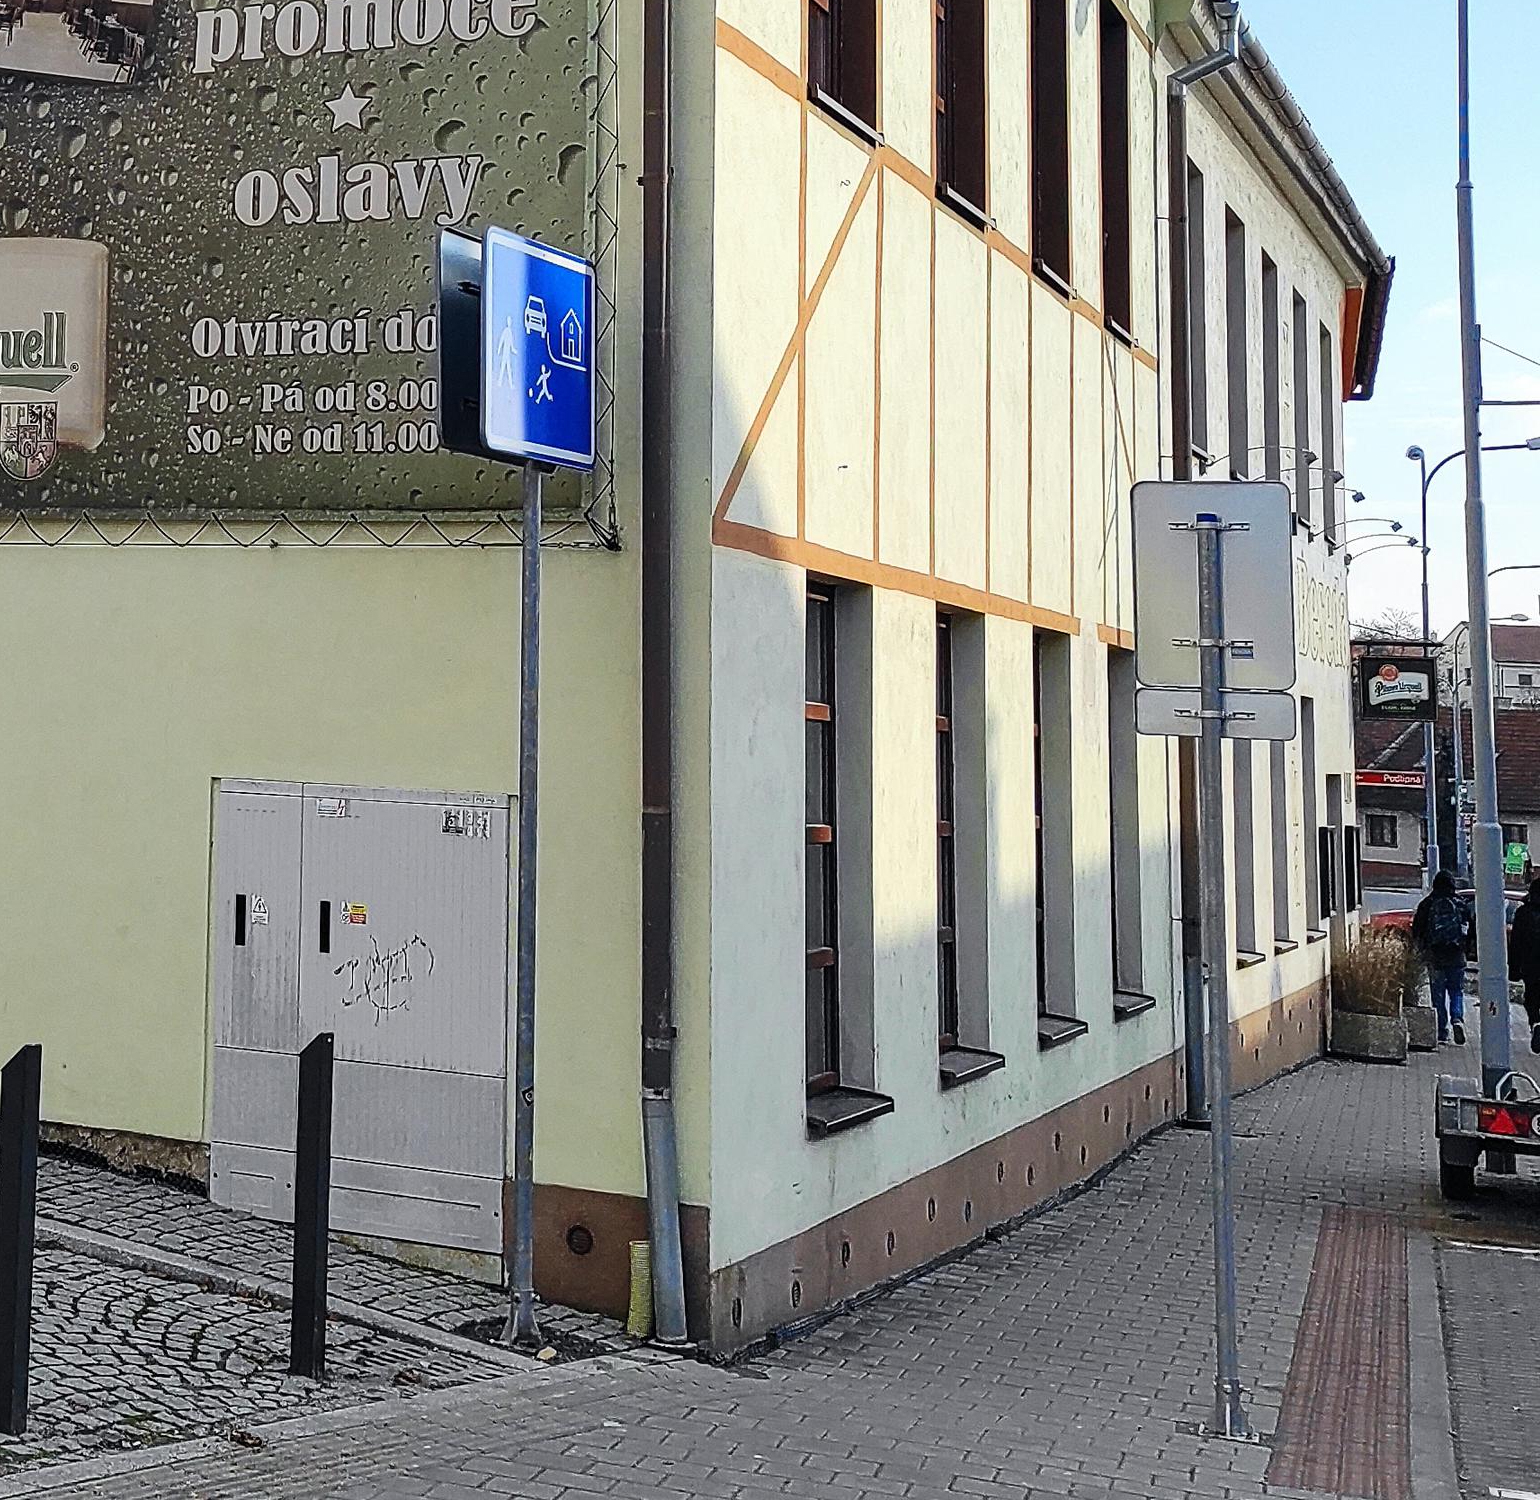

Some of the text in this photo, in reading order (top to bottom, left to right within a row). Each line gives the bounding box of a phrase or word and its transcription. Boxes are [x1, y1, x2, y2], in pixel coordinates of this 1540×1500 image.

[234, 154, 484, 227] oslavy
[191, 308, 437, 359] Otvírací do
[187, 384, 229, 414] Po
[261, 381, 305, 413] Pá
[314, 381, 357, 413] od
[365, 378, 438, 413] 8.00
[187, 423, 222, 455] So
[254, 422, 293, 454] Ne
[301, 422, 344, 454] od
[352, 420, 440, 453] 11.00
